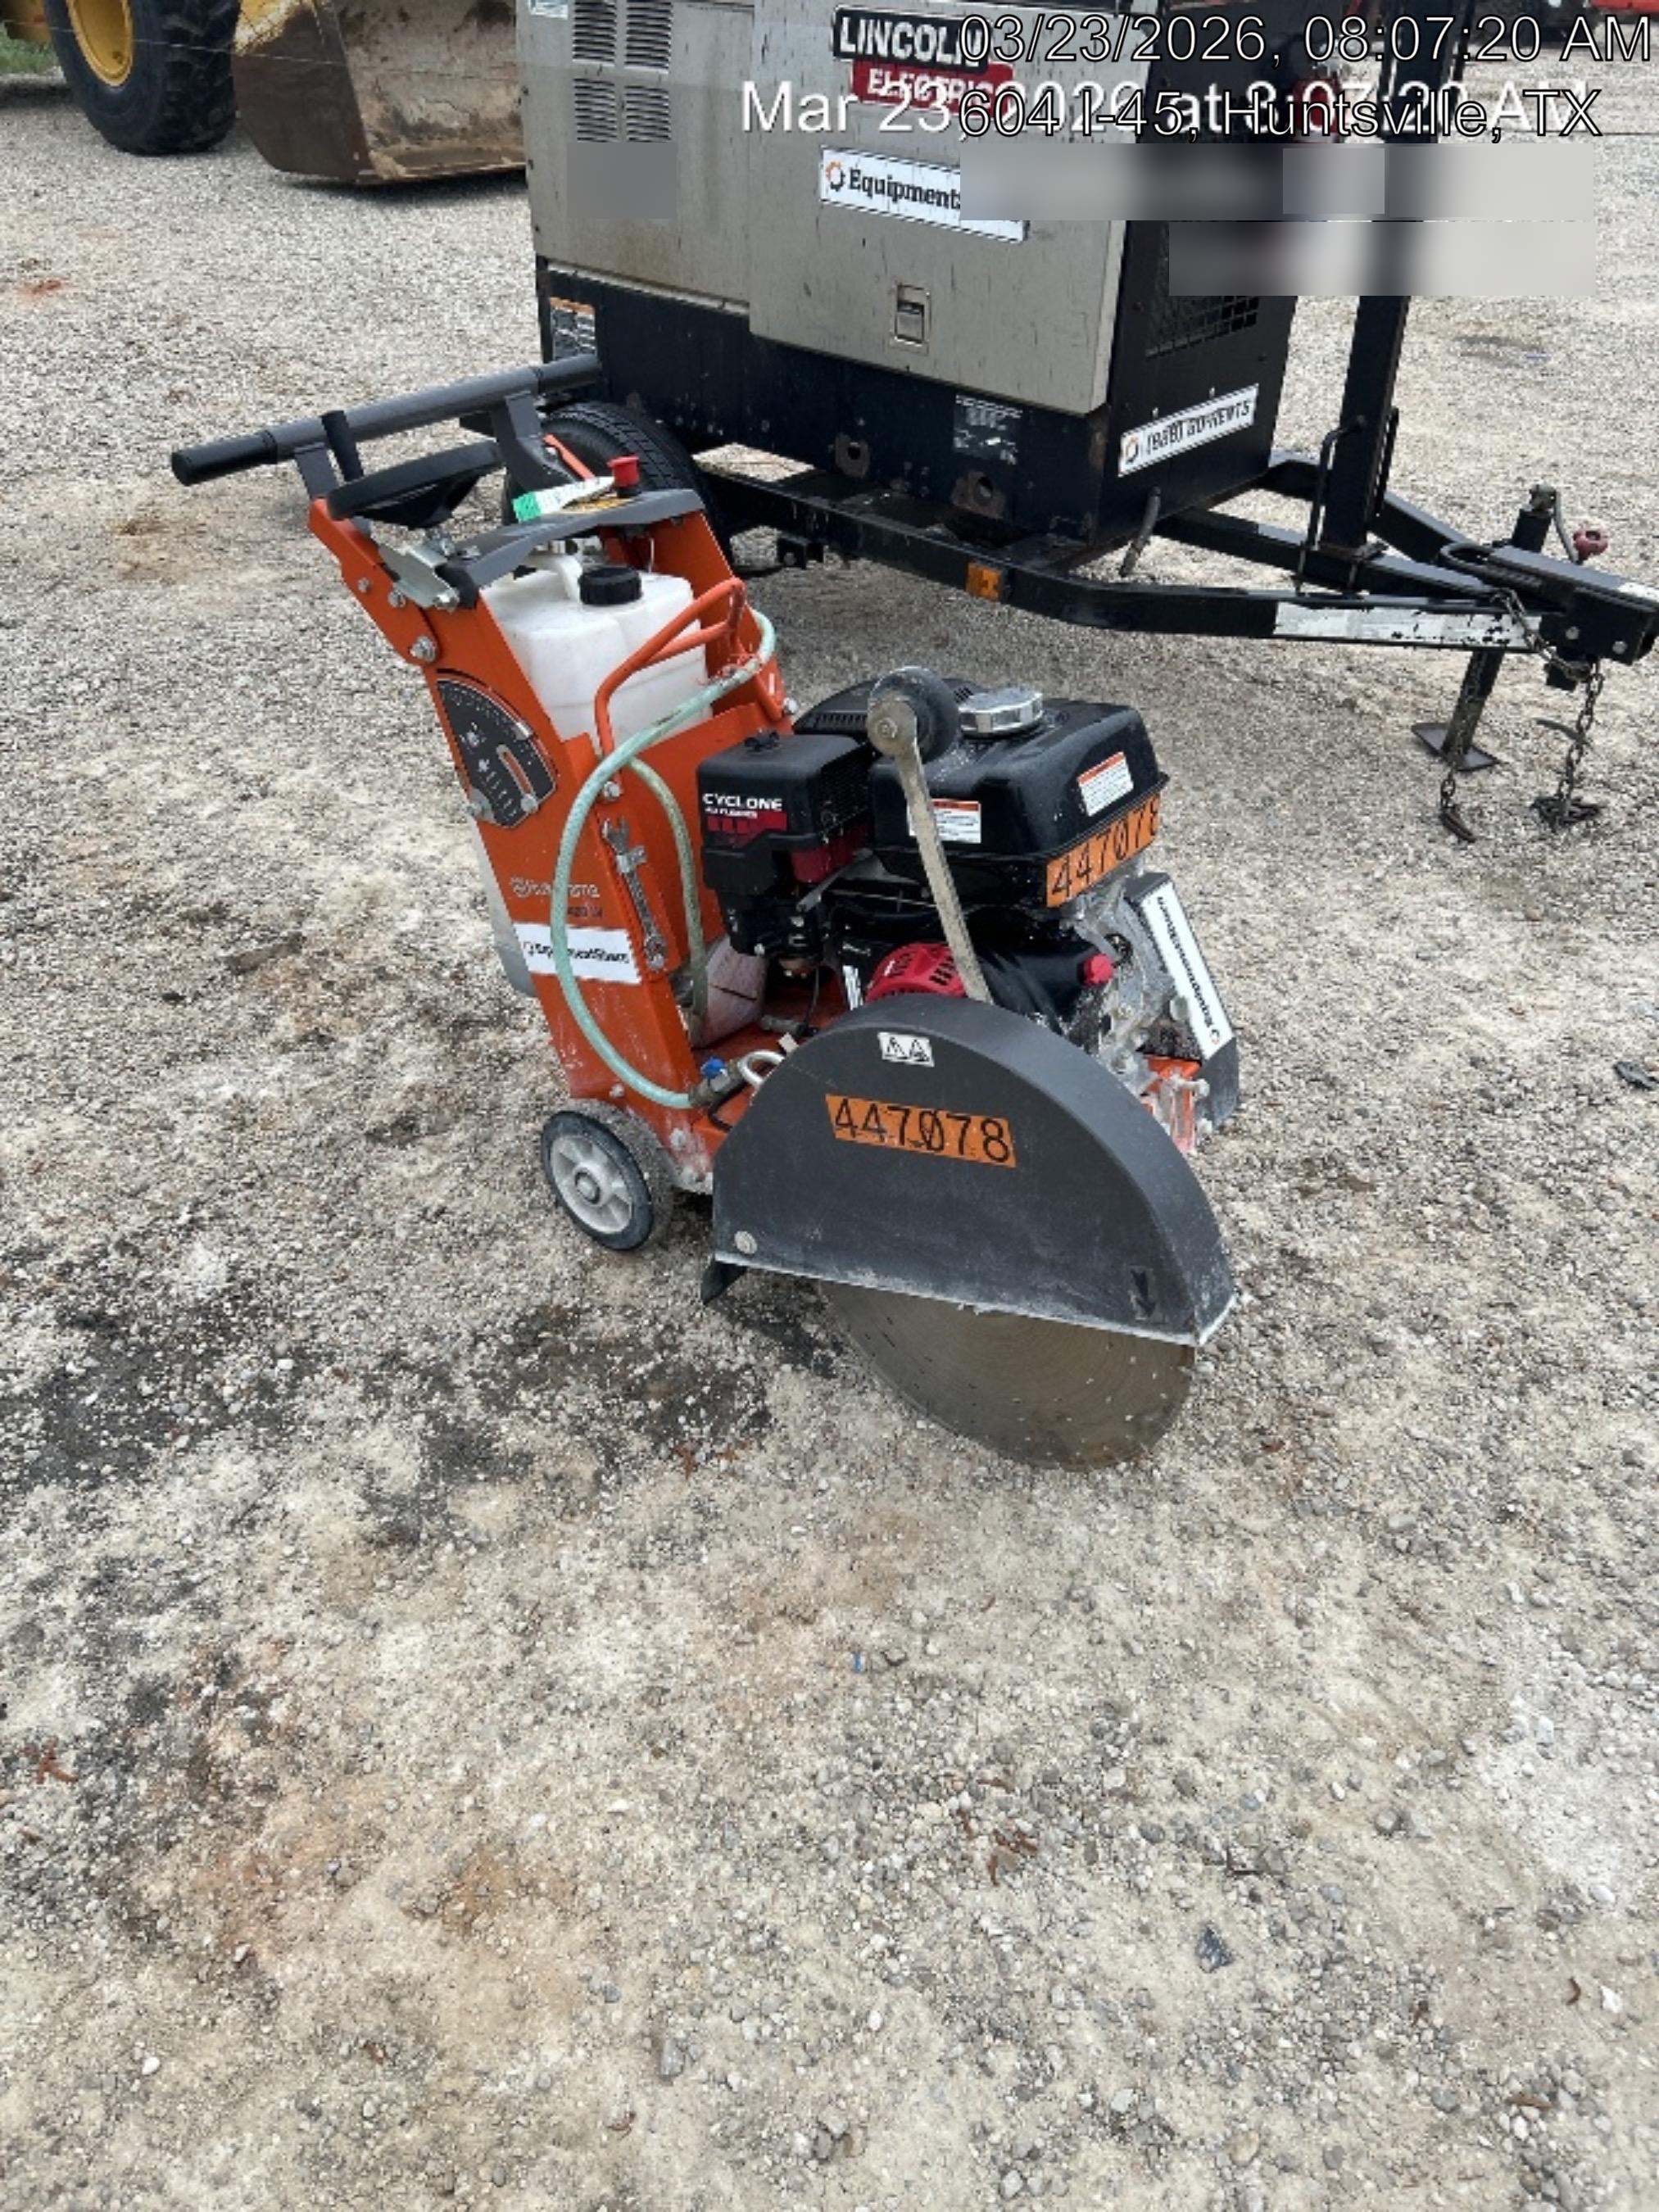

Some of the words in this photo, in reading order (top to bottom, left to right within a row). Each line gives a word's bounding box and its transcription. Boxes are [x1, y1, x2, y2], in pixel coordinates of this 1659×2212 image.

[839, 16, 983, 68] LINCOLN
[703, 793, 782, 812] CYCLONE
[834, 1097, 1011, 1163] 447078
